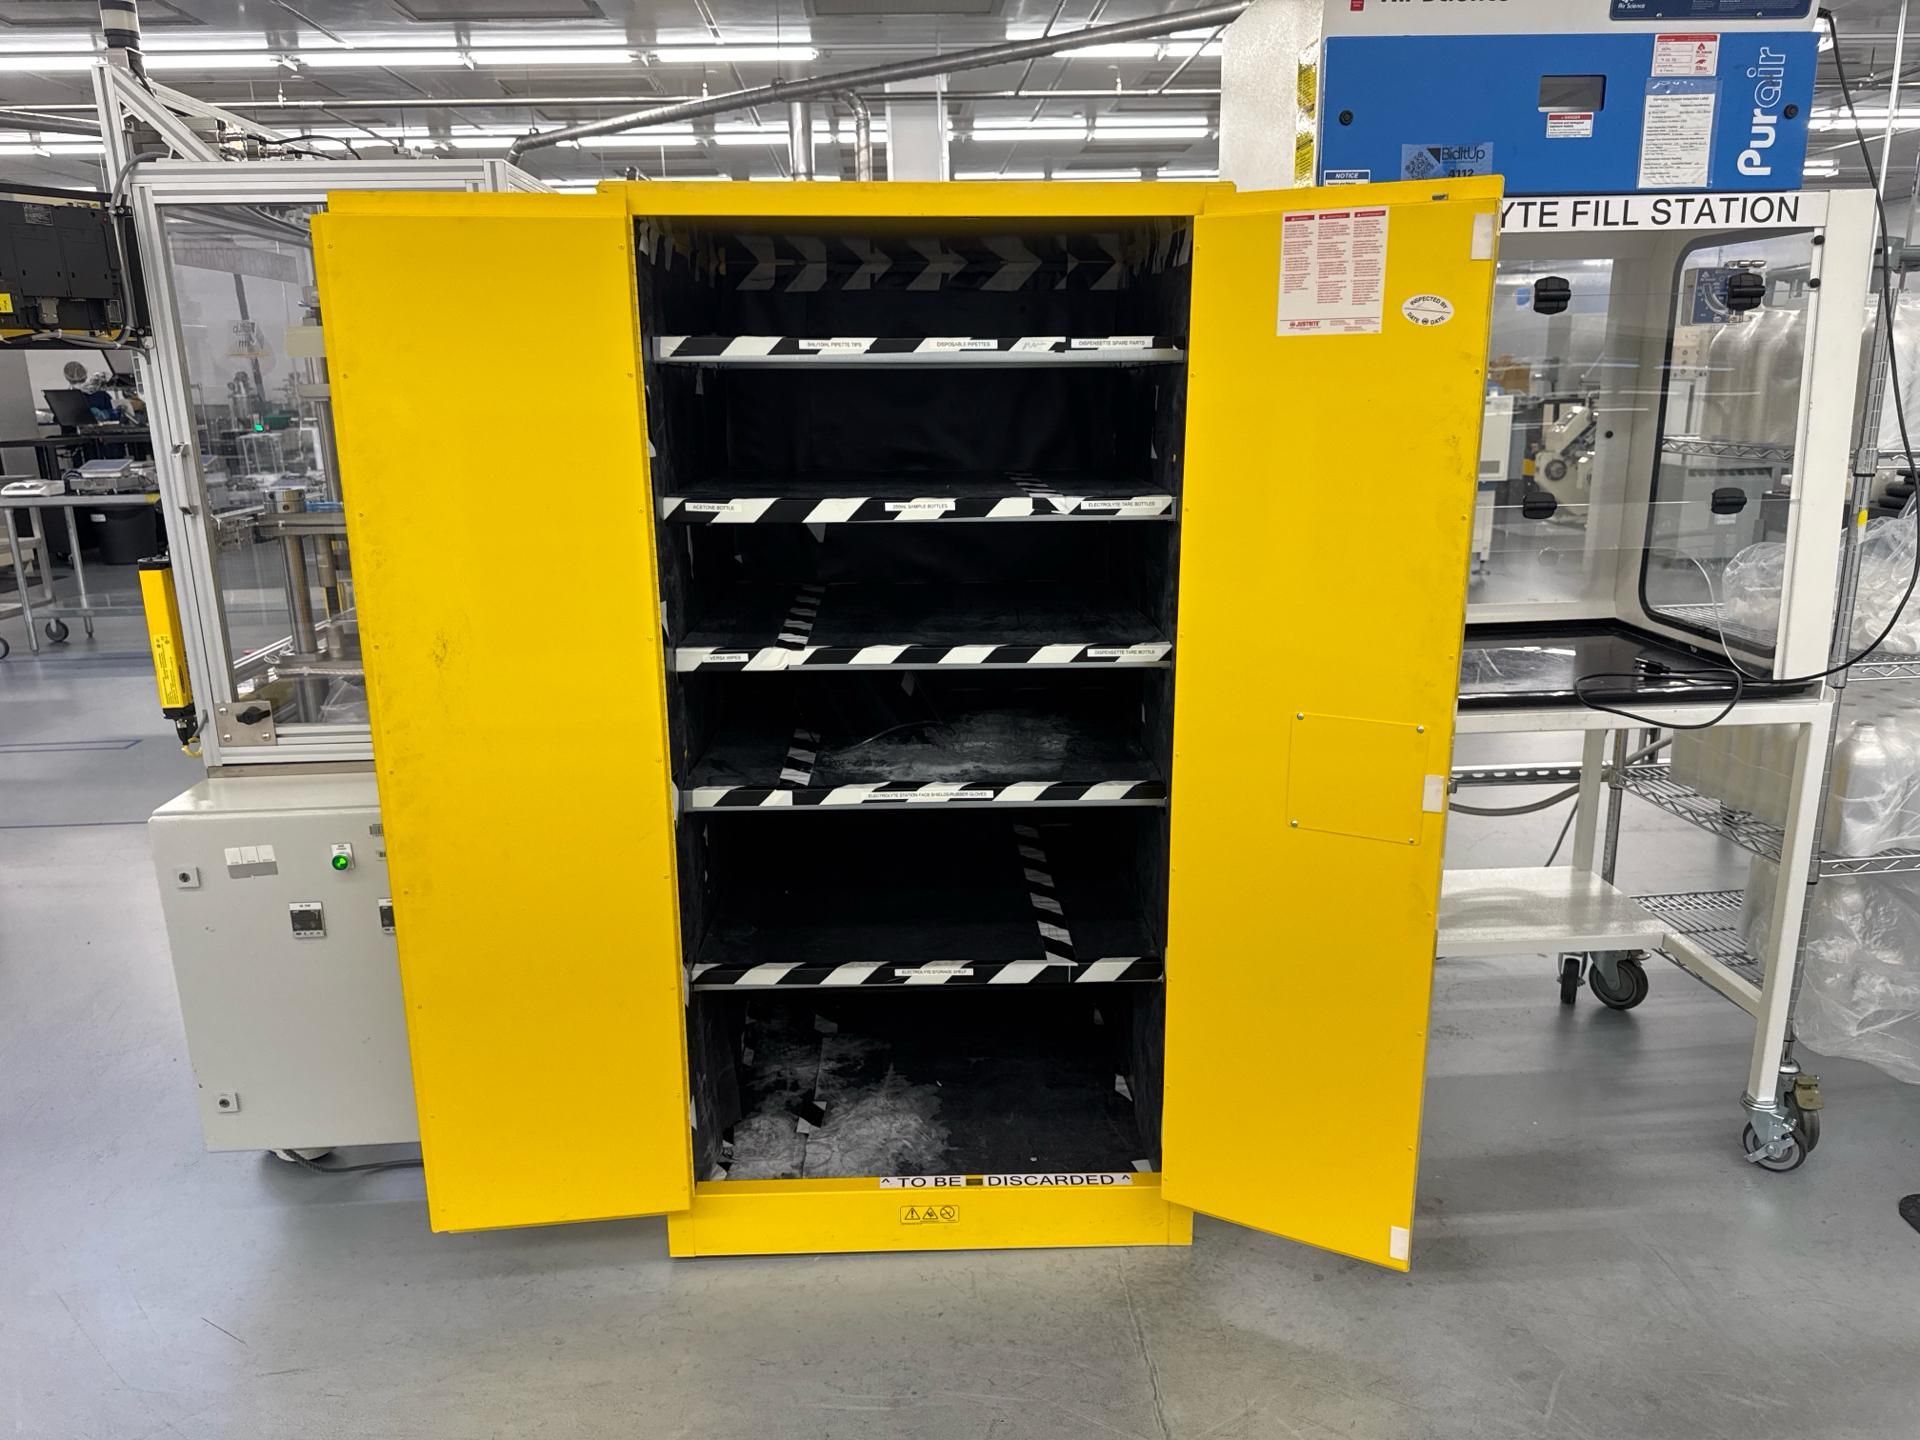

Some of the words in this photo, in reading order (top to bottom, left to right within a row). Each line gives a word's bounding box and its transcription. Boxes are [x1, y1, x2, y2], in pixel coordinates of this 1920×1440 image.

[1737, 46, 1786, 176] Purair
[1571, 199, 1639, 227] FILL
[1650, 195, 1800, 226] STATION
[1410, 295, 1441, 305] INSPECTED
[1440, 301, 1448, 309] BY
[1407, 311, 1420, 323] DATE
[1430, 315, 1446, 325] DATE
[897, 1177, 927, 1188] TO
[933, 1176, 962, 1187] BE
[987, 1174, 1115, 1187] DISCARDED
